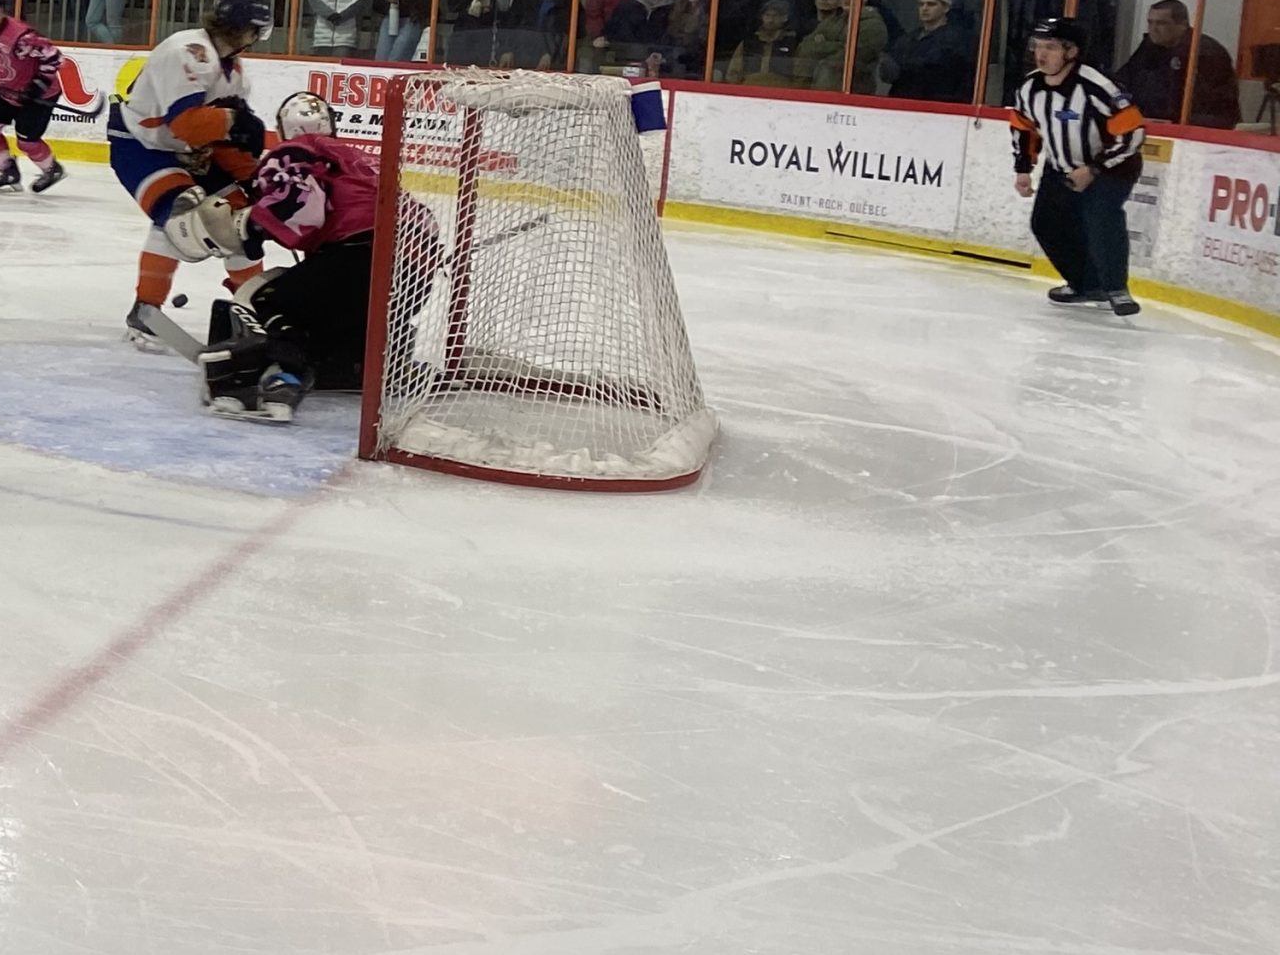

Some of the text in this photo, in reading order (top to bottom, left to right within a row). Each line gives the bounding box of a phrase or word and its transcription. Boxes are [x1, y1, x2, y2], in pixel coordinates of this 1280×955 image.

[51, 112, 96, 124] mandin
[826, 112, 858, 126] HÔTEL
[730, 139, 944, 187] ROYAL WILLIAM
[780, 194, 888, 217] SAINT-ROCH QUÉBEC
[1209, 174, 1280, 236] PRO-
